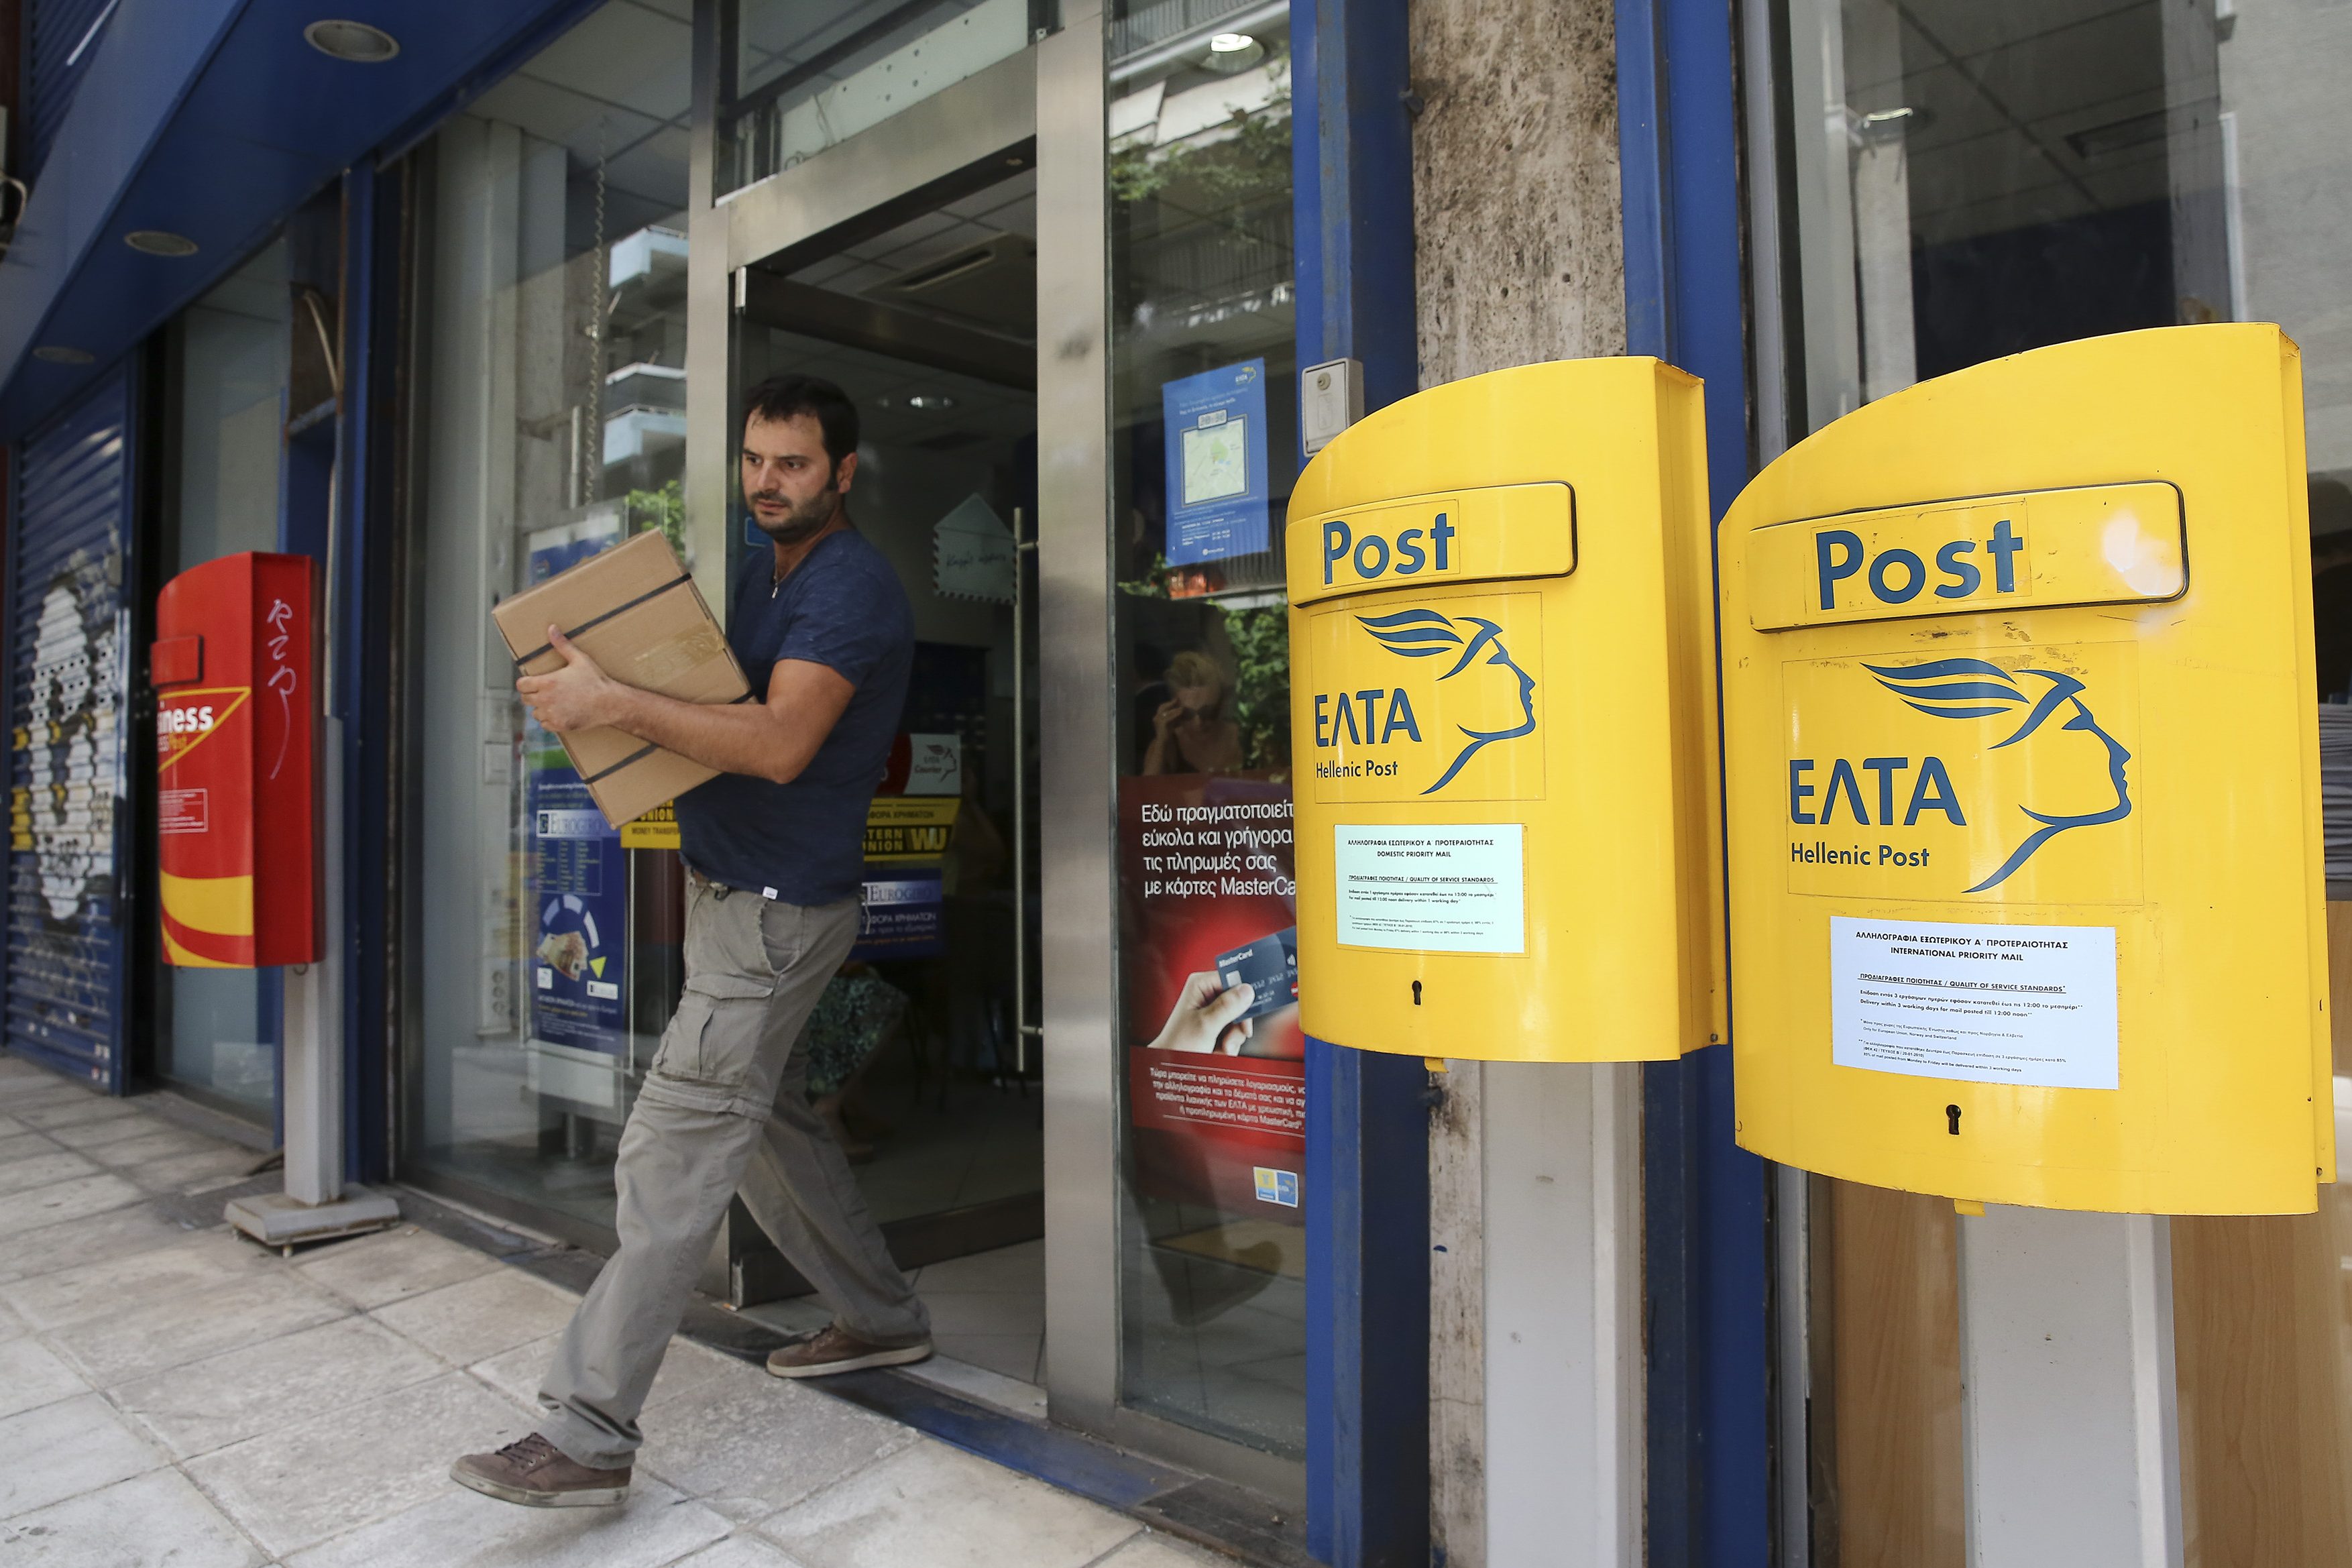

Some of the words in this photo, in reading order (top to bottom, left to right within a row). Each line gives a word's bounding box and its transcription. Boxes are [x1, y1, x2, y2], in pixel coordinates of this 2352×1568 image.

[1323, 512, 1455, 584] Post
[1815, 520, 2023, 610] Post
[1314, 687, 1422, 747] ΕΛΤΑ
[1316, 761, 1361, 778] Hellenic
[1365, 760, 1398, 777] Post
[1789, 756, 1967, 826] ΕΛΤΑ
[1141, 804, 1172, 823] Εδώ
[911, 827, 947, 851] WU
[1142, 827, 1194, 847] εύκολα
[1198, 831, 1220, 845] και
[1226, 828, 1293, 849] γρήγορα
[1143, 856, 1162, 873] τις
[1167, 852, 1241, 874] πληρωμές
[1245, 856, 1277, 873] σας
[1791, 842, 1871, 865] Hellenic
[1879, 844, 1930, 867] Post
[1145, 882, 1162, 898] με
[1165, 879, 1216, 898] κάρτες
[1856, 932, 1918, 942] ΑΛΛΗΛΟΓΡΑΦΙΑ
[1920, 936, 1972, 945] ΕΞΩΤΕΡΙΚΟΥ
[1986, 940, 2069, 948] ΠΡΟΤΕΡΑΙΟΤΗΤΑΣ
[1891, 947, 1956, 958] INTERNATIONAL
[1958, 952, 1999, 960] PRIORITY
[1860, 974, 1905, 983] ΠΡΟΔΙΑΓΡΑΦΕΣ
